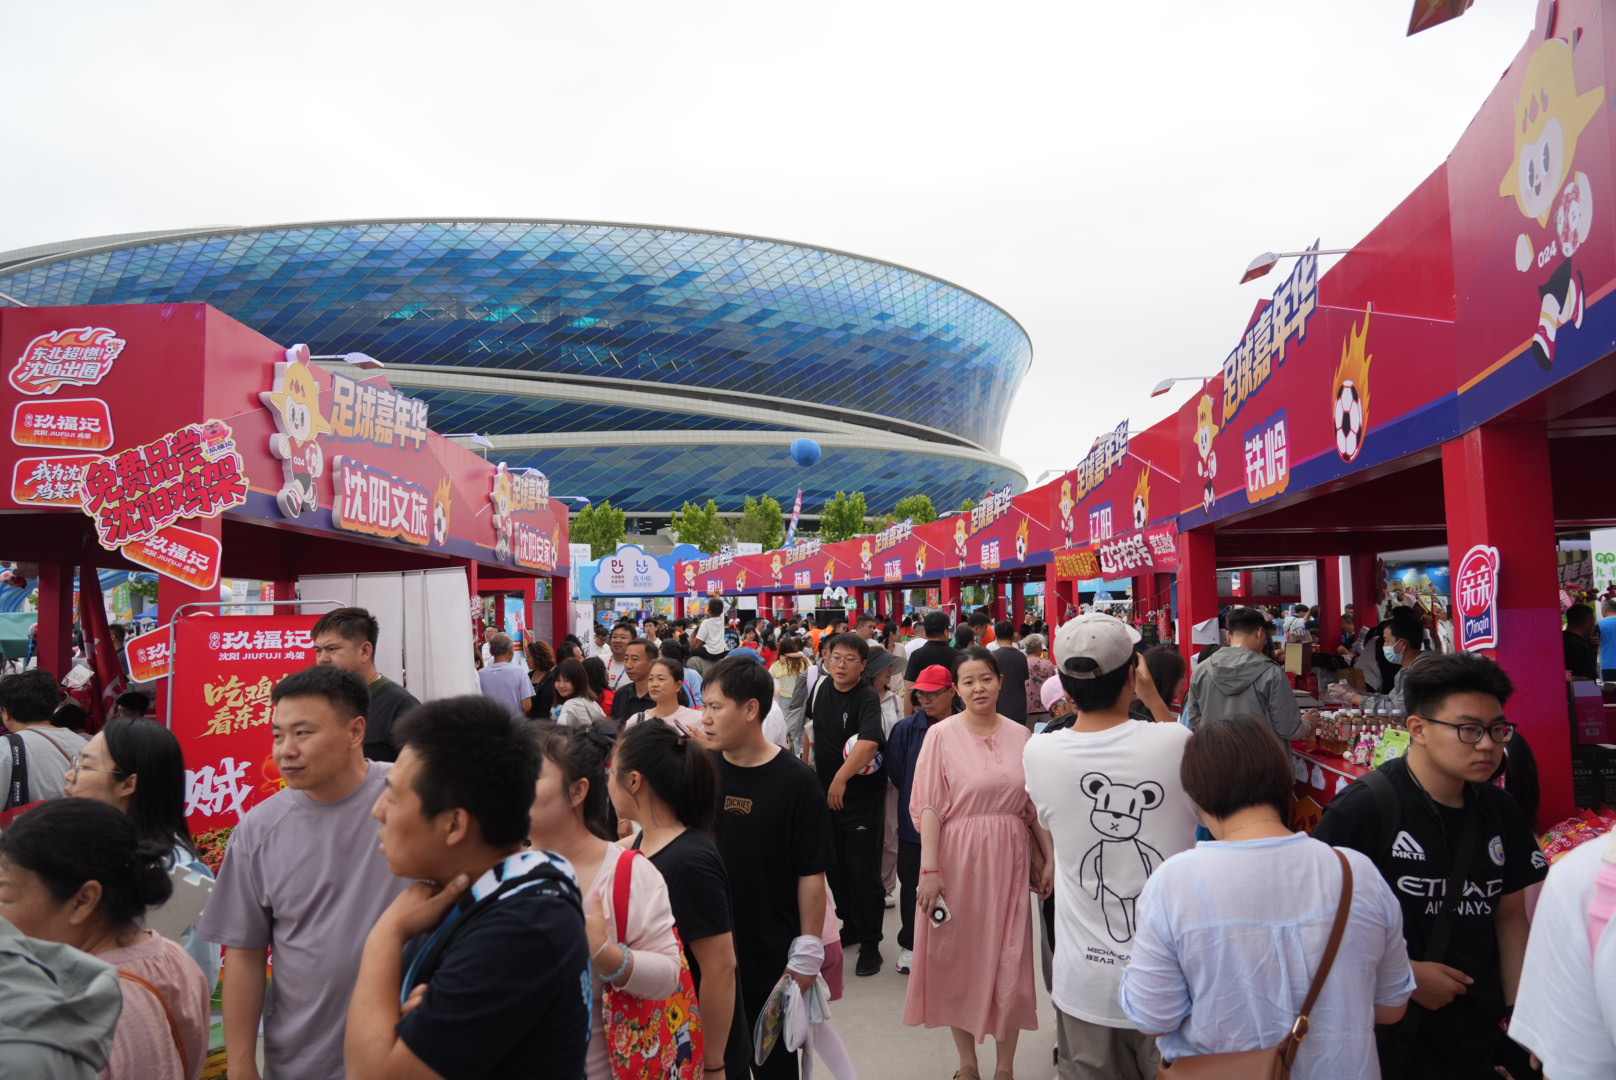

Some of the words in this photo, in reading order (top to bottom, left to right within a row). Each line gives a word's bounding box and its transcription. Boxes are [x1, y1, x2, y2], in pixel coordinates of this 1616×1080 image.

[1537, 240, 1557, 268] 024
[1221, 238, 1320, 433] 足球嘉年华
[17, 361, 102, 383] 沈阳出圈
[33, 414, 102, 432] 玖福记
[327, 371, 429, 450] 足球嘉年华
[24, 459, 82, 486] 我为沈
[86, 430, 206, 512] 免费品尝
[1076, 418, 1129, 506] 足球嘉年华
[1244, 419, 1287, 493] 铁岭
[101, 457, 247, 543] 沈阳鸡架
[344, 466, 429, 537] 沈阳文旅
[513, 473, 549, 512] 足球嘉年华
[970, 483, 1013, 536] 足球嘉年华
[145, 535, 210, 571] 玖福记
[873, 516, 914, 556] 足球嘉年华
[981, 540, 1000, 565] 阜新
[1101, 533, 1154, 573] 辽宁老字号
[885, 560, 901, 578] 本溪
[218, 651, 240, 661] 沈阳
[242, 652, 281, 660] JIUFUJI
[284, 651, 305, 660] 鸡架
[221, 630, 314, 650] 玖福记
[204, 673, 289, 707] 吃鸡
[725, 796, 751, 813] DICKIES
[1392, 850, 1426, 861] MKTR
[1397, 875, 1503, 898] ETIAD
[1085, 953, 1115, 965] BEAR
